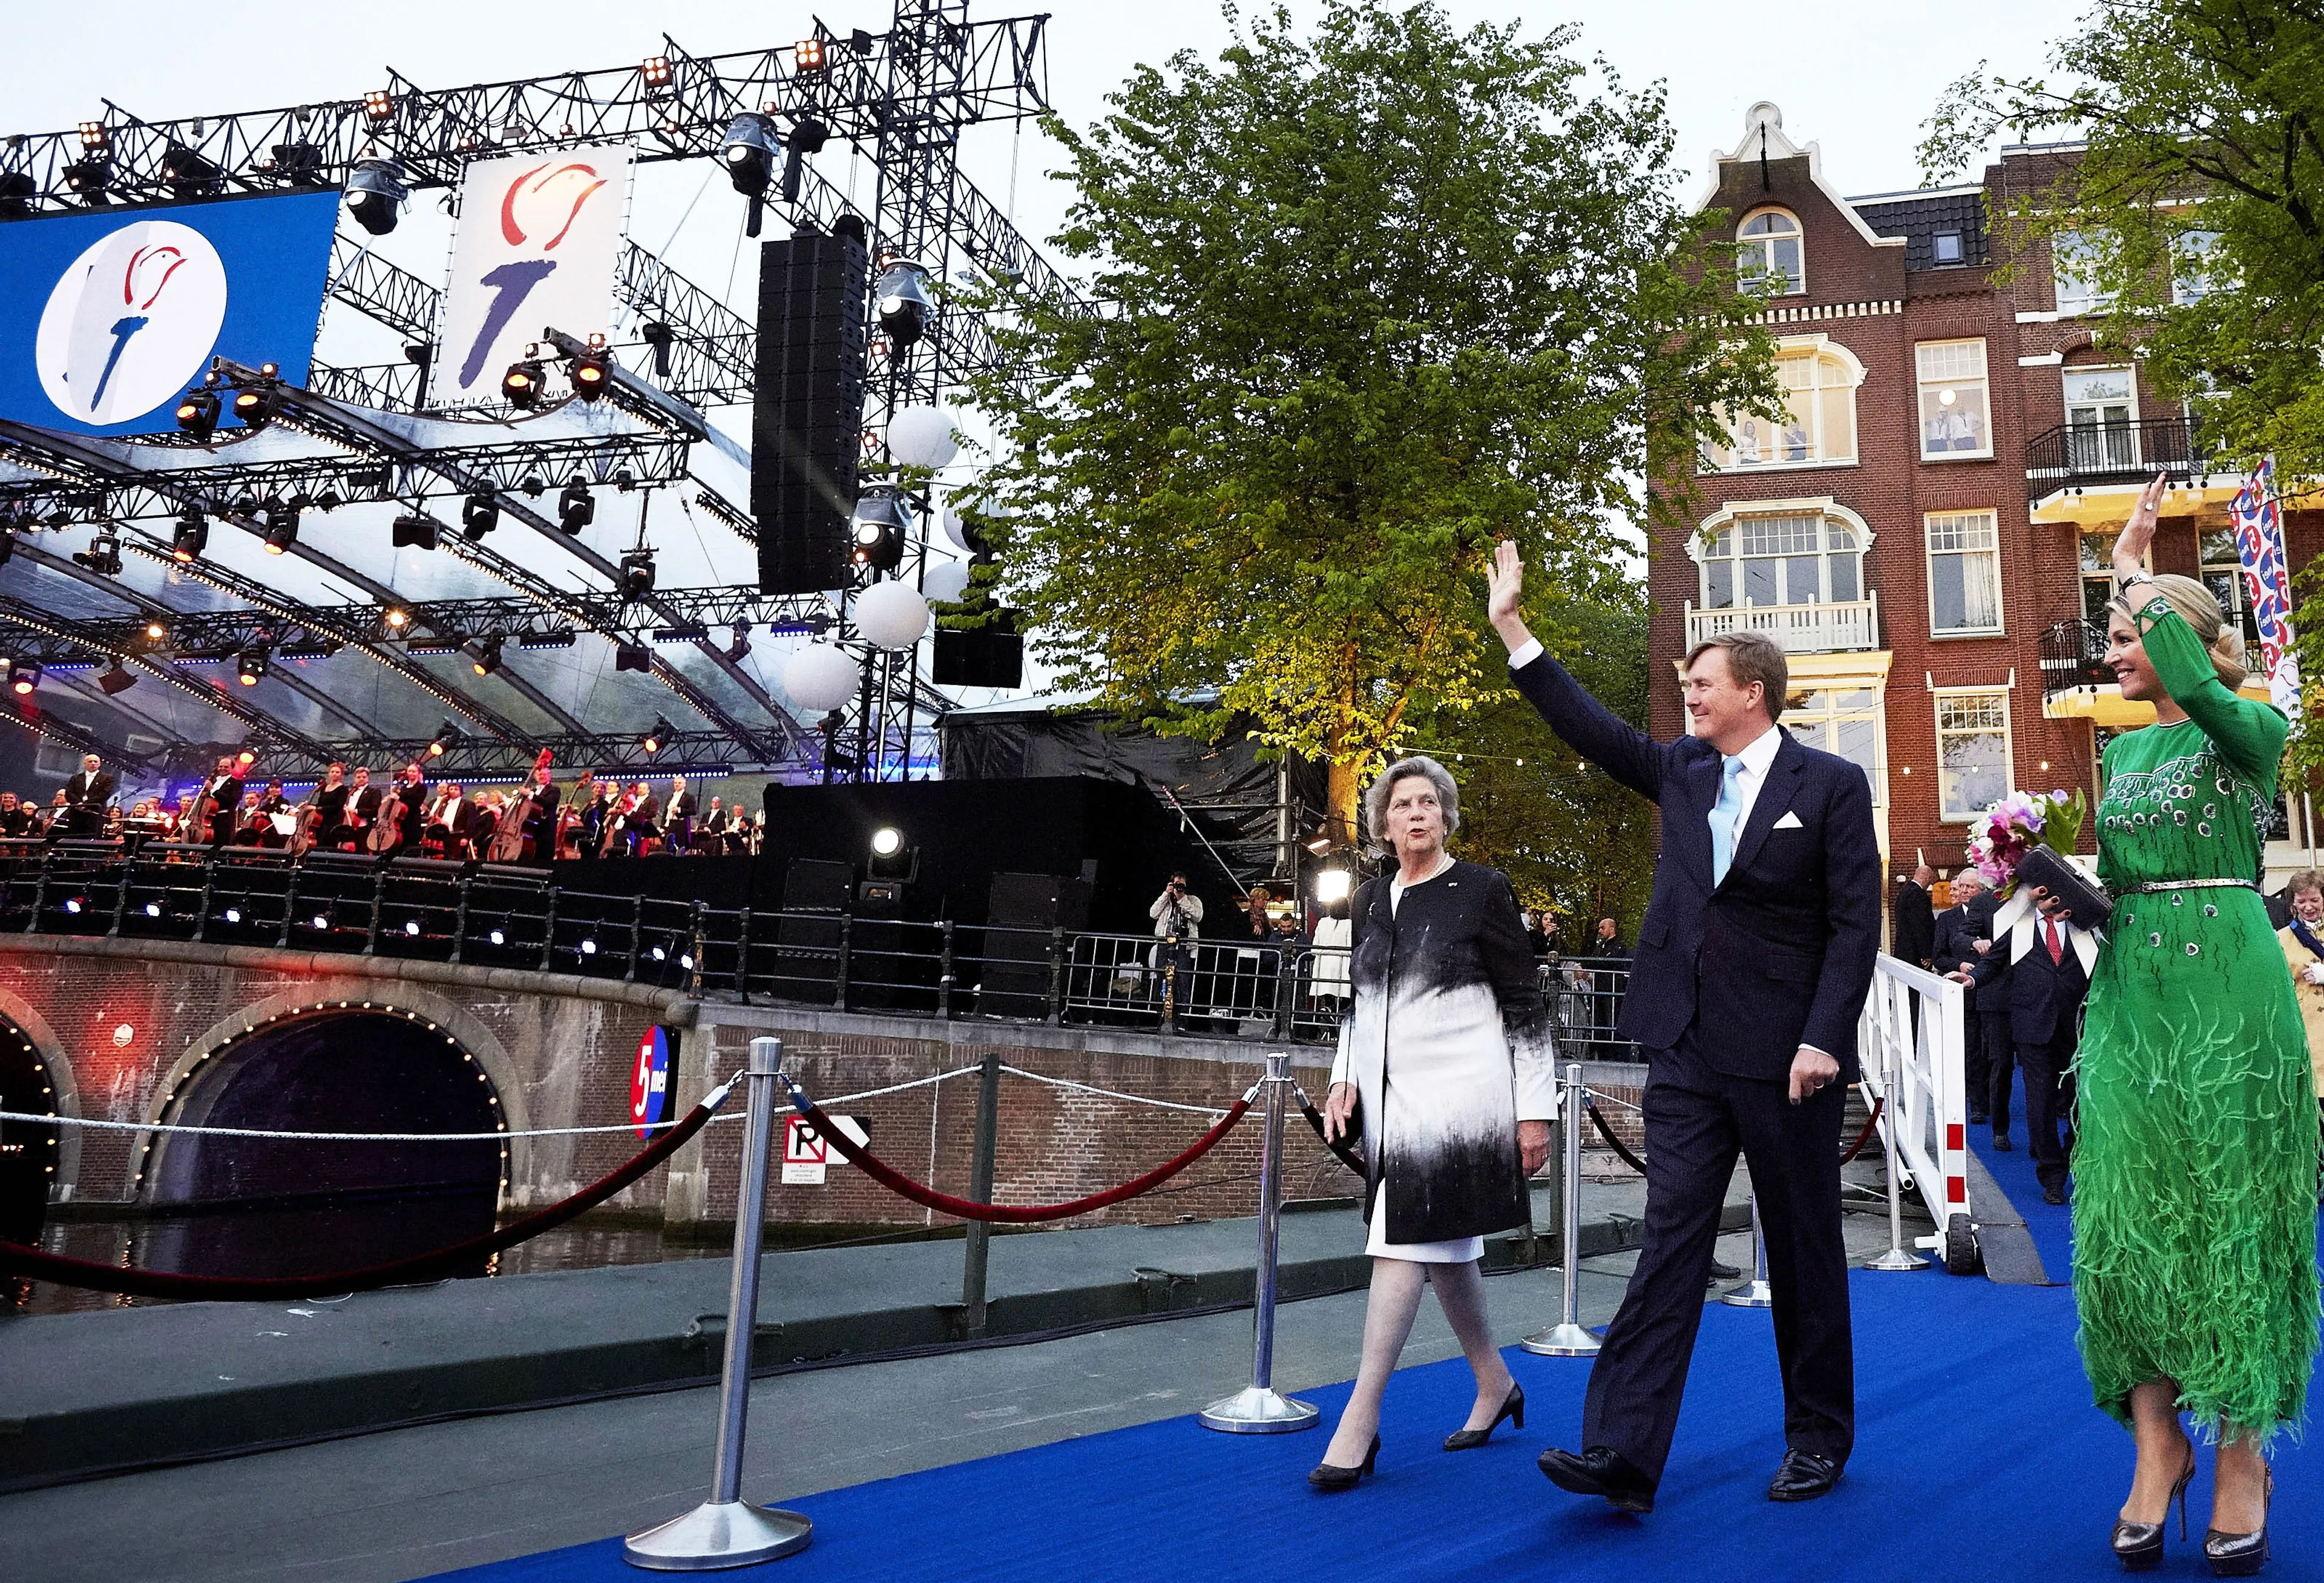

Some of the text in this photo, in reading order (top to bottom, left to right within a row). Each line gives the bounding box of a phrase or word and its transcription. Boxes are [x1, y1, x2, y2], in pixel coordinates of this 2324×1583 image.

[634, 1045, 668, 1117] 5 mei
[795, 1124, 820, 1156] P
